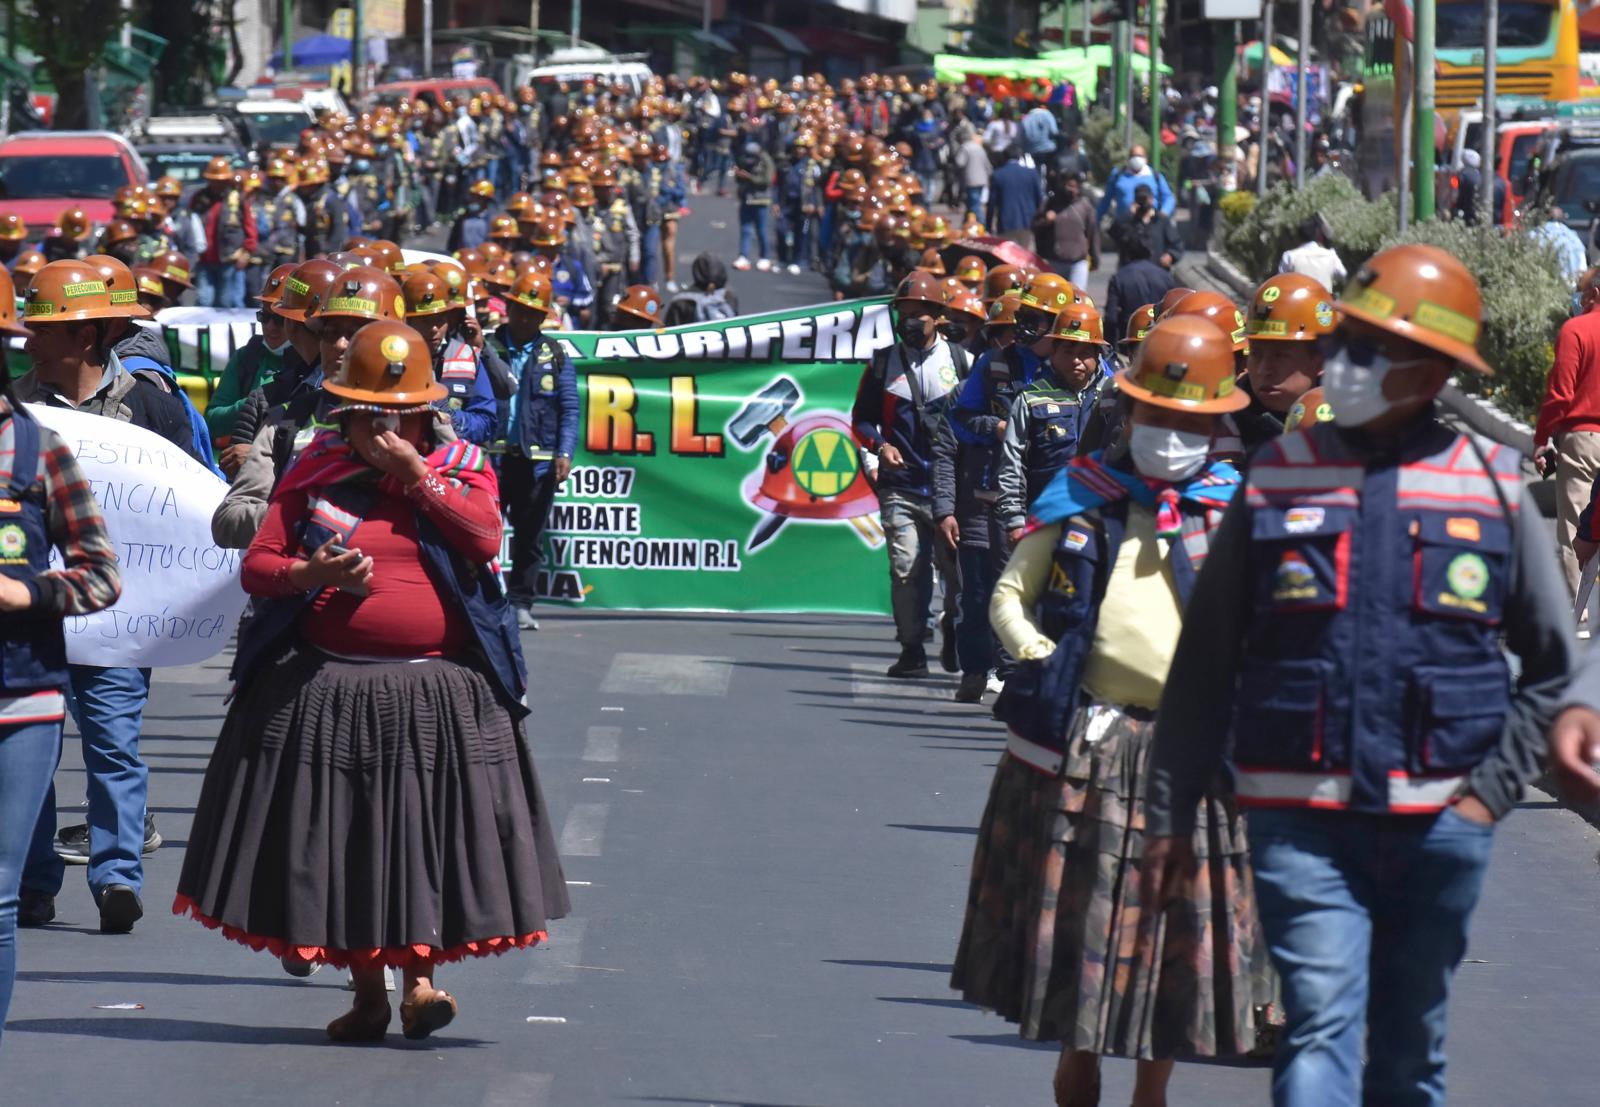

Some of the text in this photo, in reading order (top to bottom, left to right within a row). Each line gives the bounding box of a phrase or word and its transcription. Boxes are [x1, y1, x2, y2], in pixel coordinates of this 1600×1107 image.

[595, 304, 896, 360] AURIFERA
[586, 373, 725, 456] R. L.
[571, 468, 632, 495] 1987
[552, 539, 568, 563] Y
[573, 540, 697, 567] FENCOMIN
[704, 542, 738, 568] R.L
